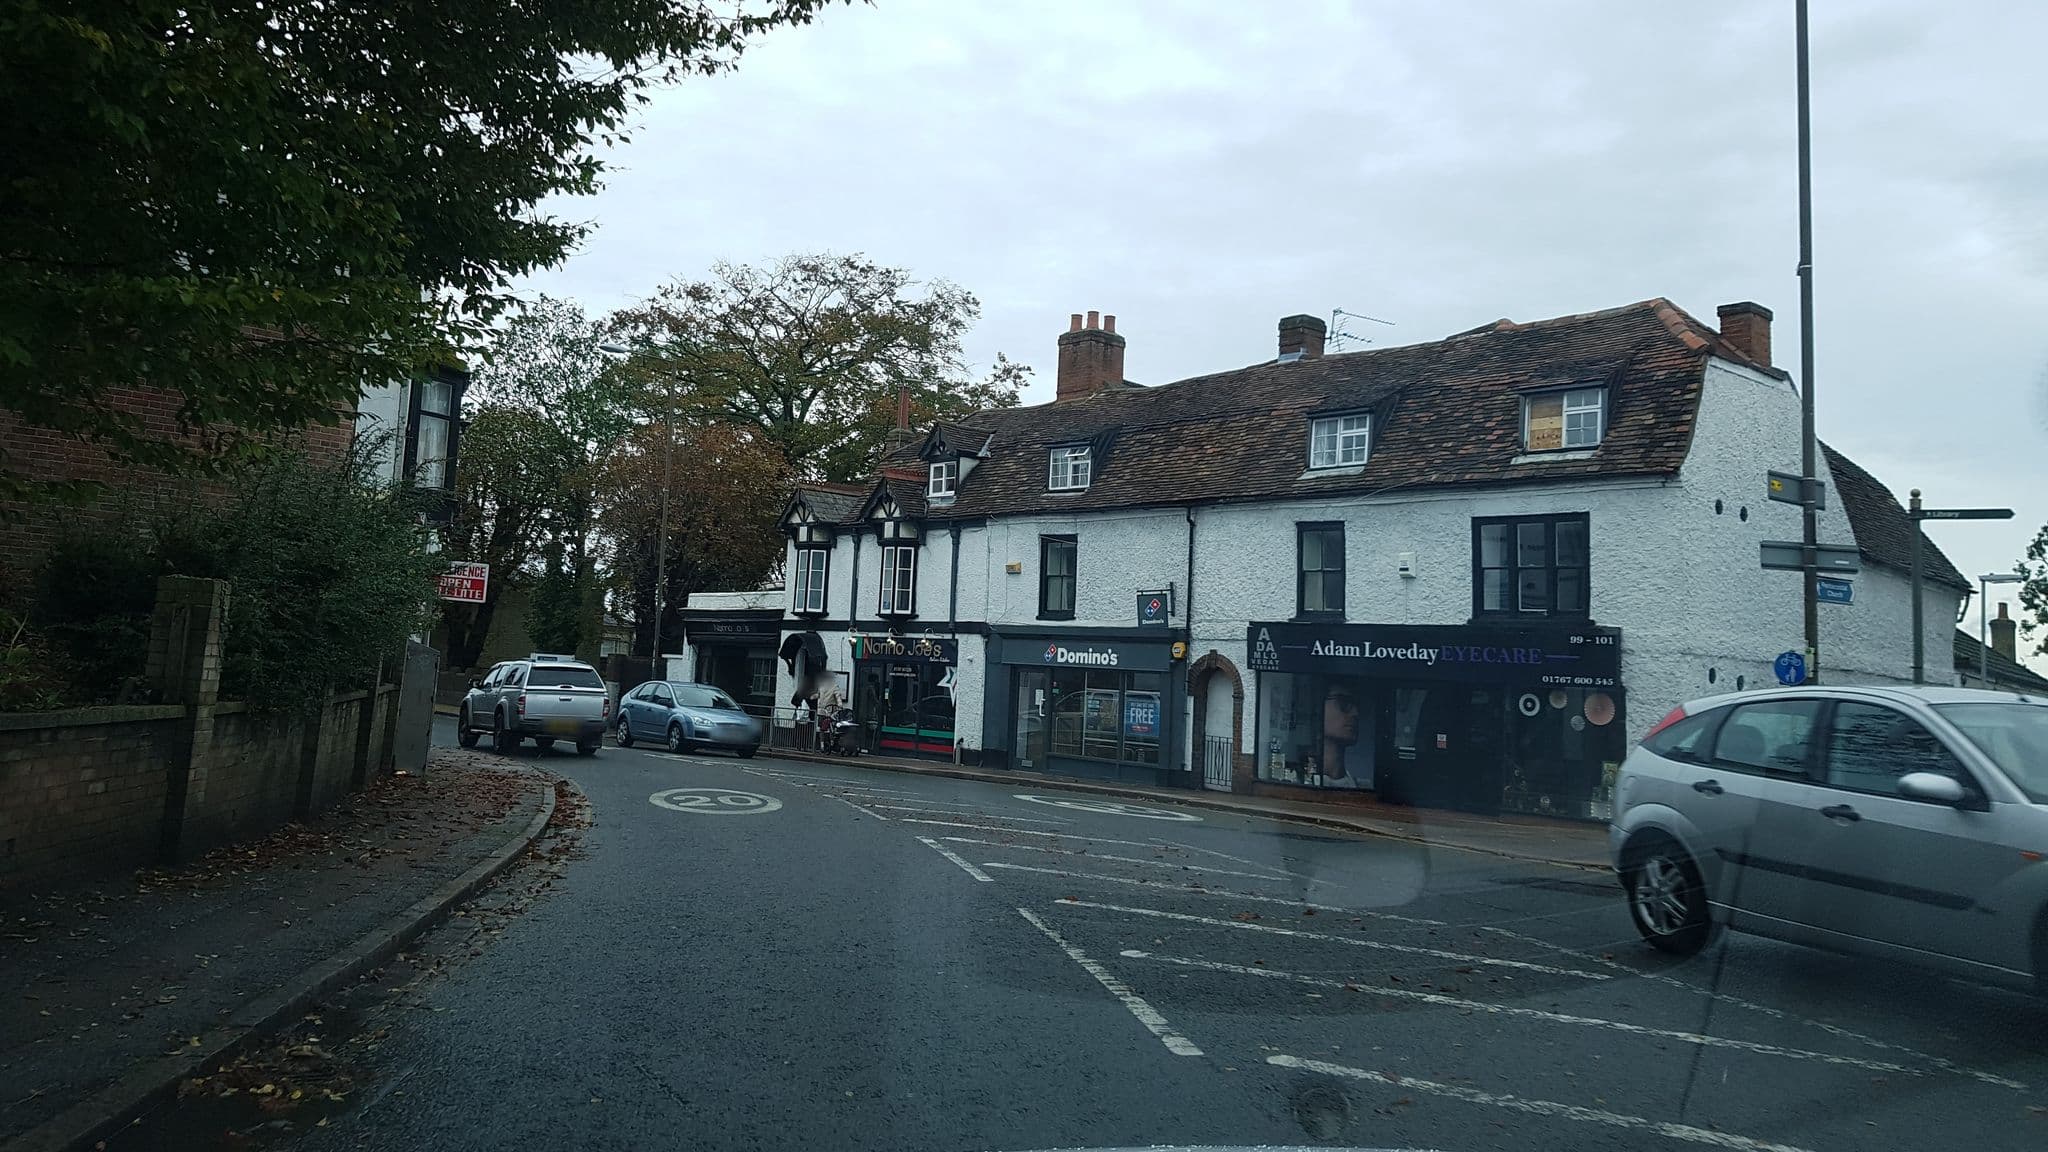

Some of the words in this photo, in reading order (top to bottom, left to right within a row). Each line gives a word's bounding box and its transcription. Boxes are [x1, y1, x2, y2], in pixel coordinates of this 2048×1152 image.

[440, 577, 471, 589] OPEN
[1258, 627, 1270, 641] A
[1569, 636, 1584, 645] 99
[1595, 636, 1614, 645] 101
[1057, 647, 1118, 666] Domino's
[1310, 639, 1360, 657] Adam
[1363, 641, 1439, 666] Loveday
[1440, 645, 1543, 665] EYECARE
[1542, 675, 1571, 684] 01767
[1595, 677, 1614, 686] 545
[1130, 708, 1154, 725] FREE
[672, 795, 763, 806] 20
